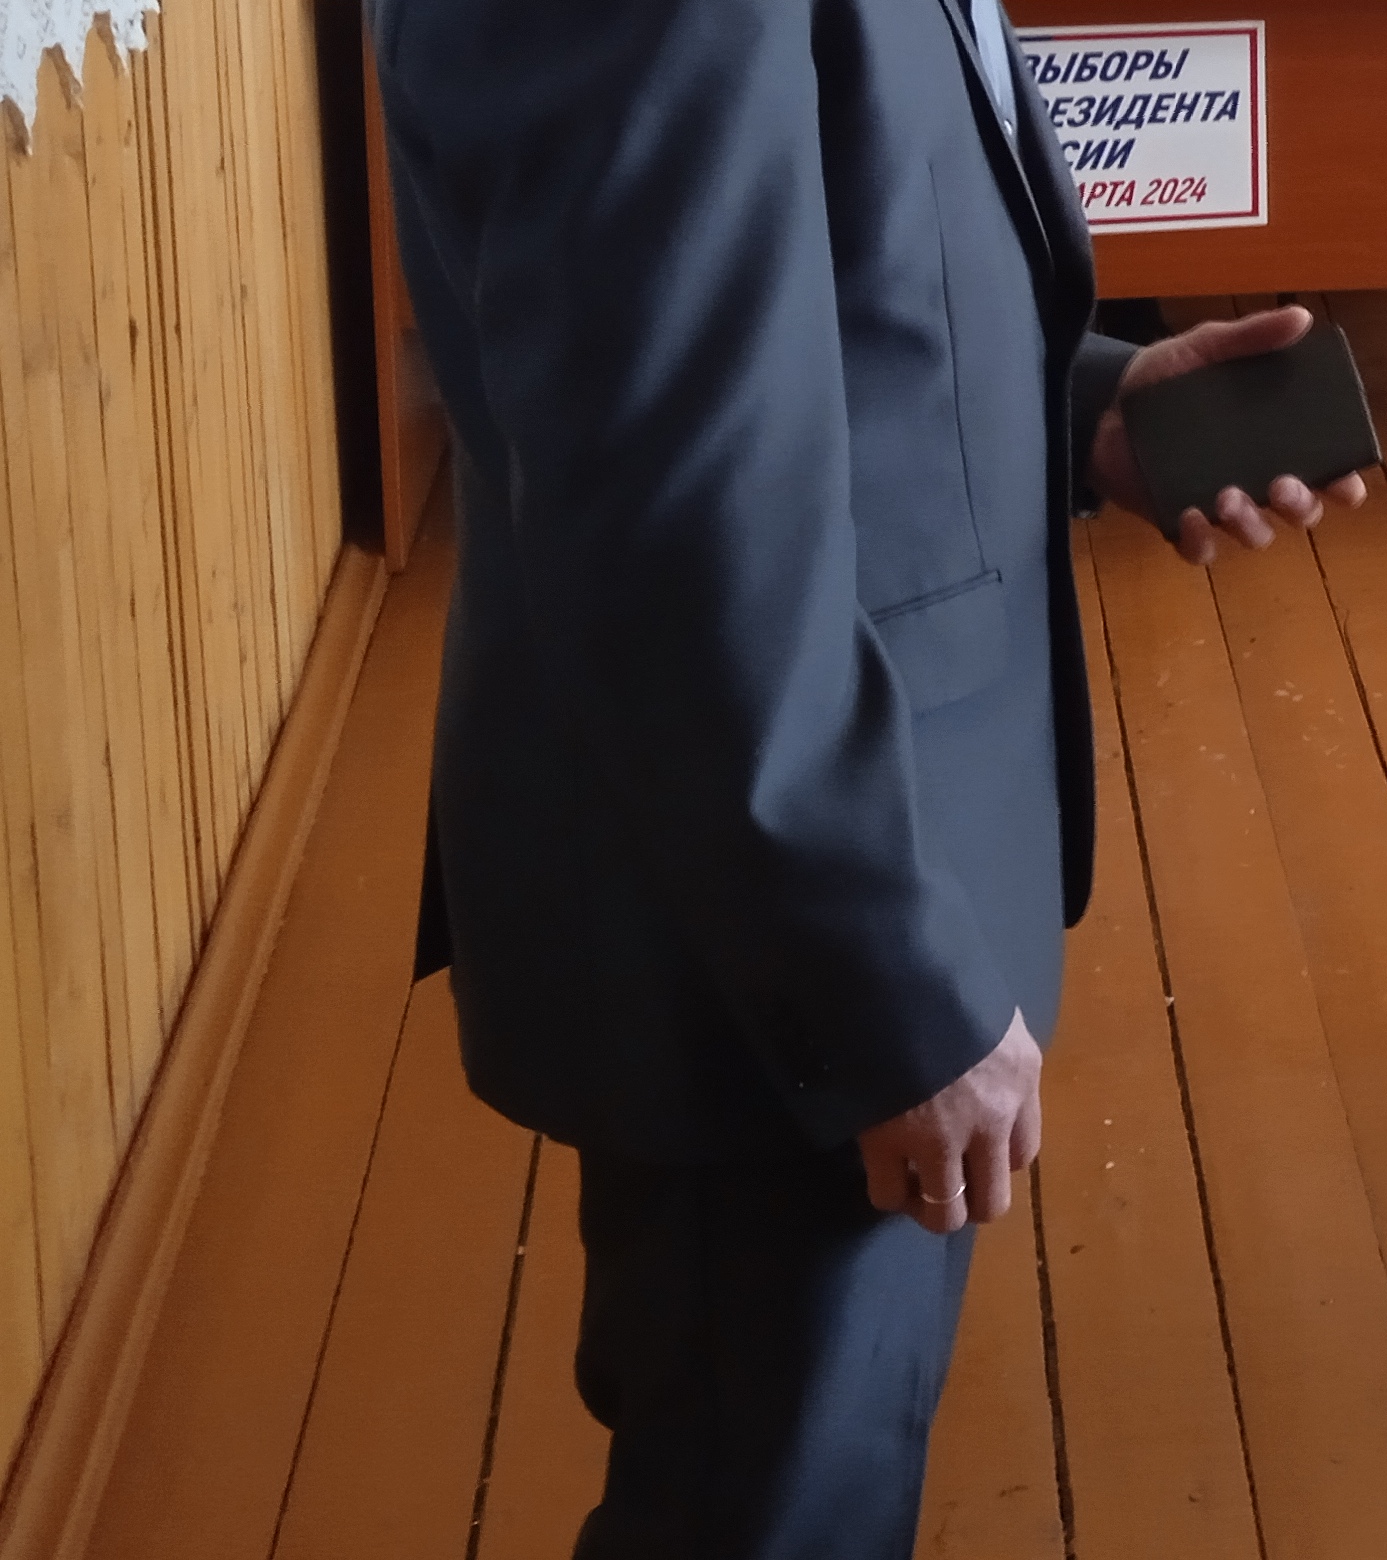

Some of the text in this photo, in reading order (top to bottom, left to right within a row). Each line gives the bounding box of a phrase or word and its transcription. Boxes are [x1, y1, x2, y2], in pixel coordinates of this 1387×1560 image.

[1045, 90, 1240, 130] ЕЗИДЕНТА
[1061, 138, 1136, 171] СИИ
[1079, 177, 1208, 208] РТА 2024
